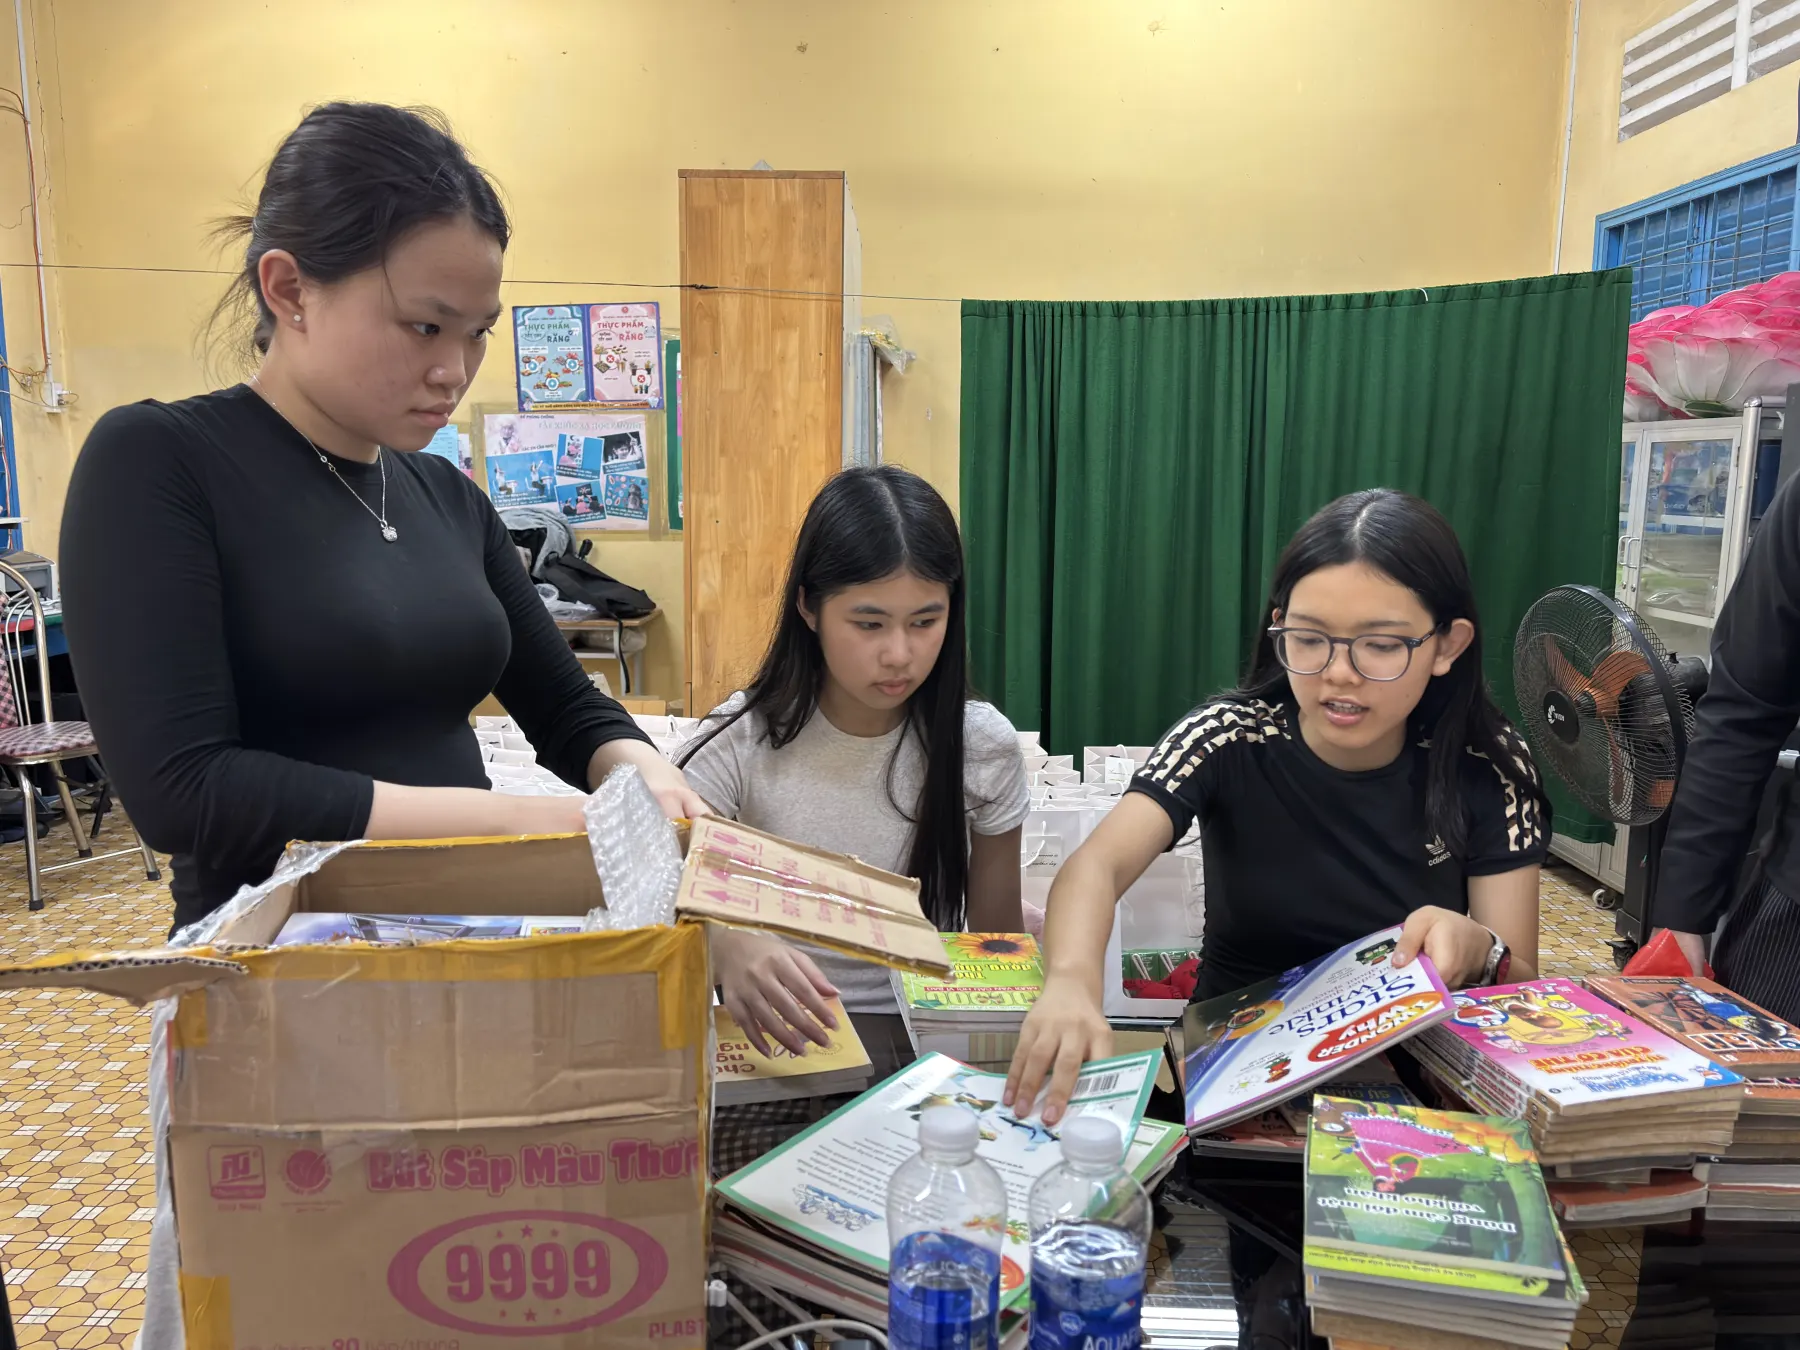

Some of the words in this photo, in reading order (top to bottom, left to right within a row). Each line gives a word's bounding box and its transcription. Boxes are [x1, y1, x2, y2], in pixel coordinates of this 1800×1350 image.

[547, 332, 570, 343] RĂNG
[597, 321, 620, 330] THỰC
[619, 331, 644, 342] RĂNG
[1428, 851, 1451, 866] adidas
[1268, 973, 1400, 1036] Twinkle
[1296, 975, 1415, 1037] Stars
[1338, 1004, 1405, 1041] Why
[1317, 1011, 1418, 1059] WONDER
[366, 1146, 435, 1192] Bút
[440, 1145, 515, 1197] Sắp
[521, 1140, 604, 1188] Màu
[445, 1239, 612, 1302] 9999
